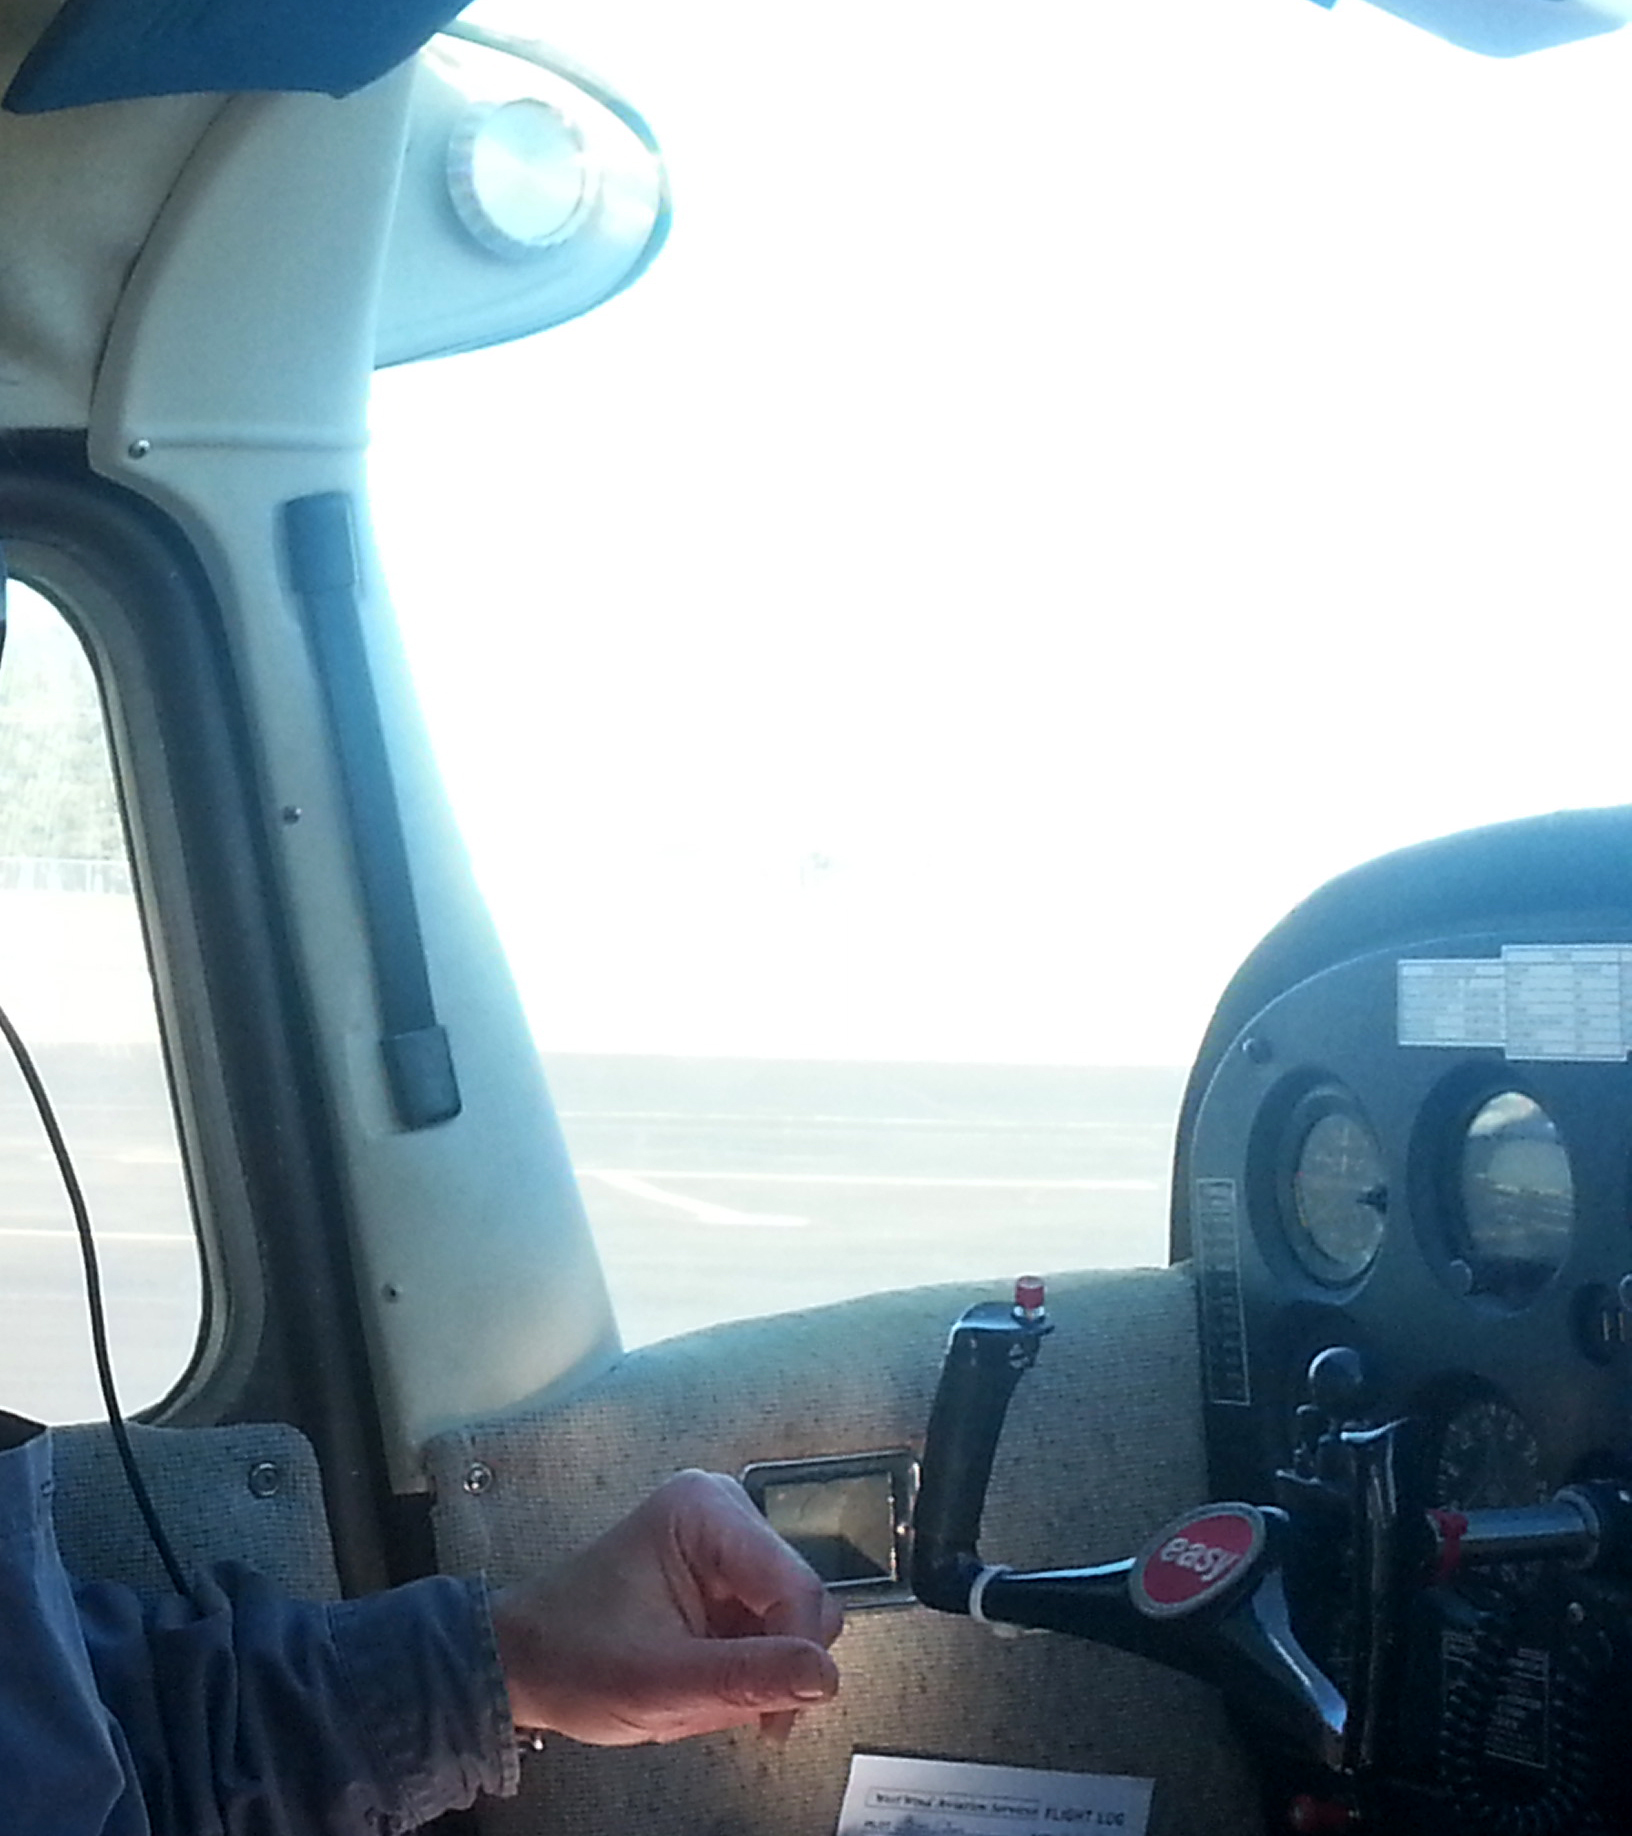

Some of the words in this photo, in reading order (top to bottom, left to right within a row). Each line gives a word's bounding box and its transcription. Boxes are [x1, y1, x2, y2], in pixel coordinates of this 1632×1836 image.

[1161, 1537, 1241, 1581] easy
[1044, 1807, 1093, 1822] FLIGHT
[1096, 1812, 1125, 1826] LOG
